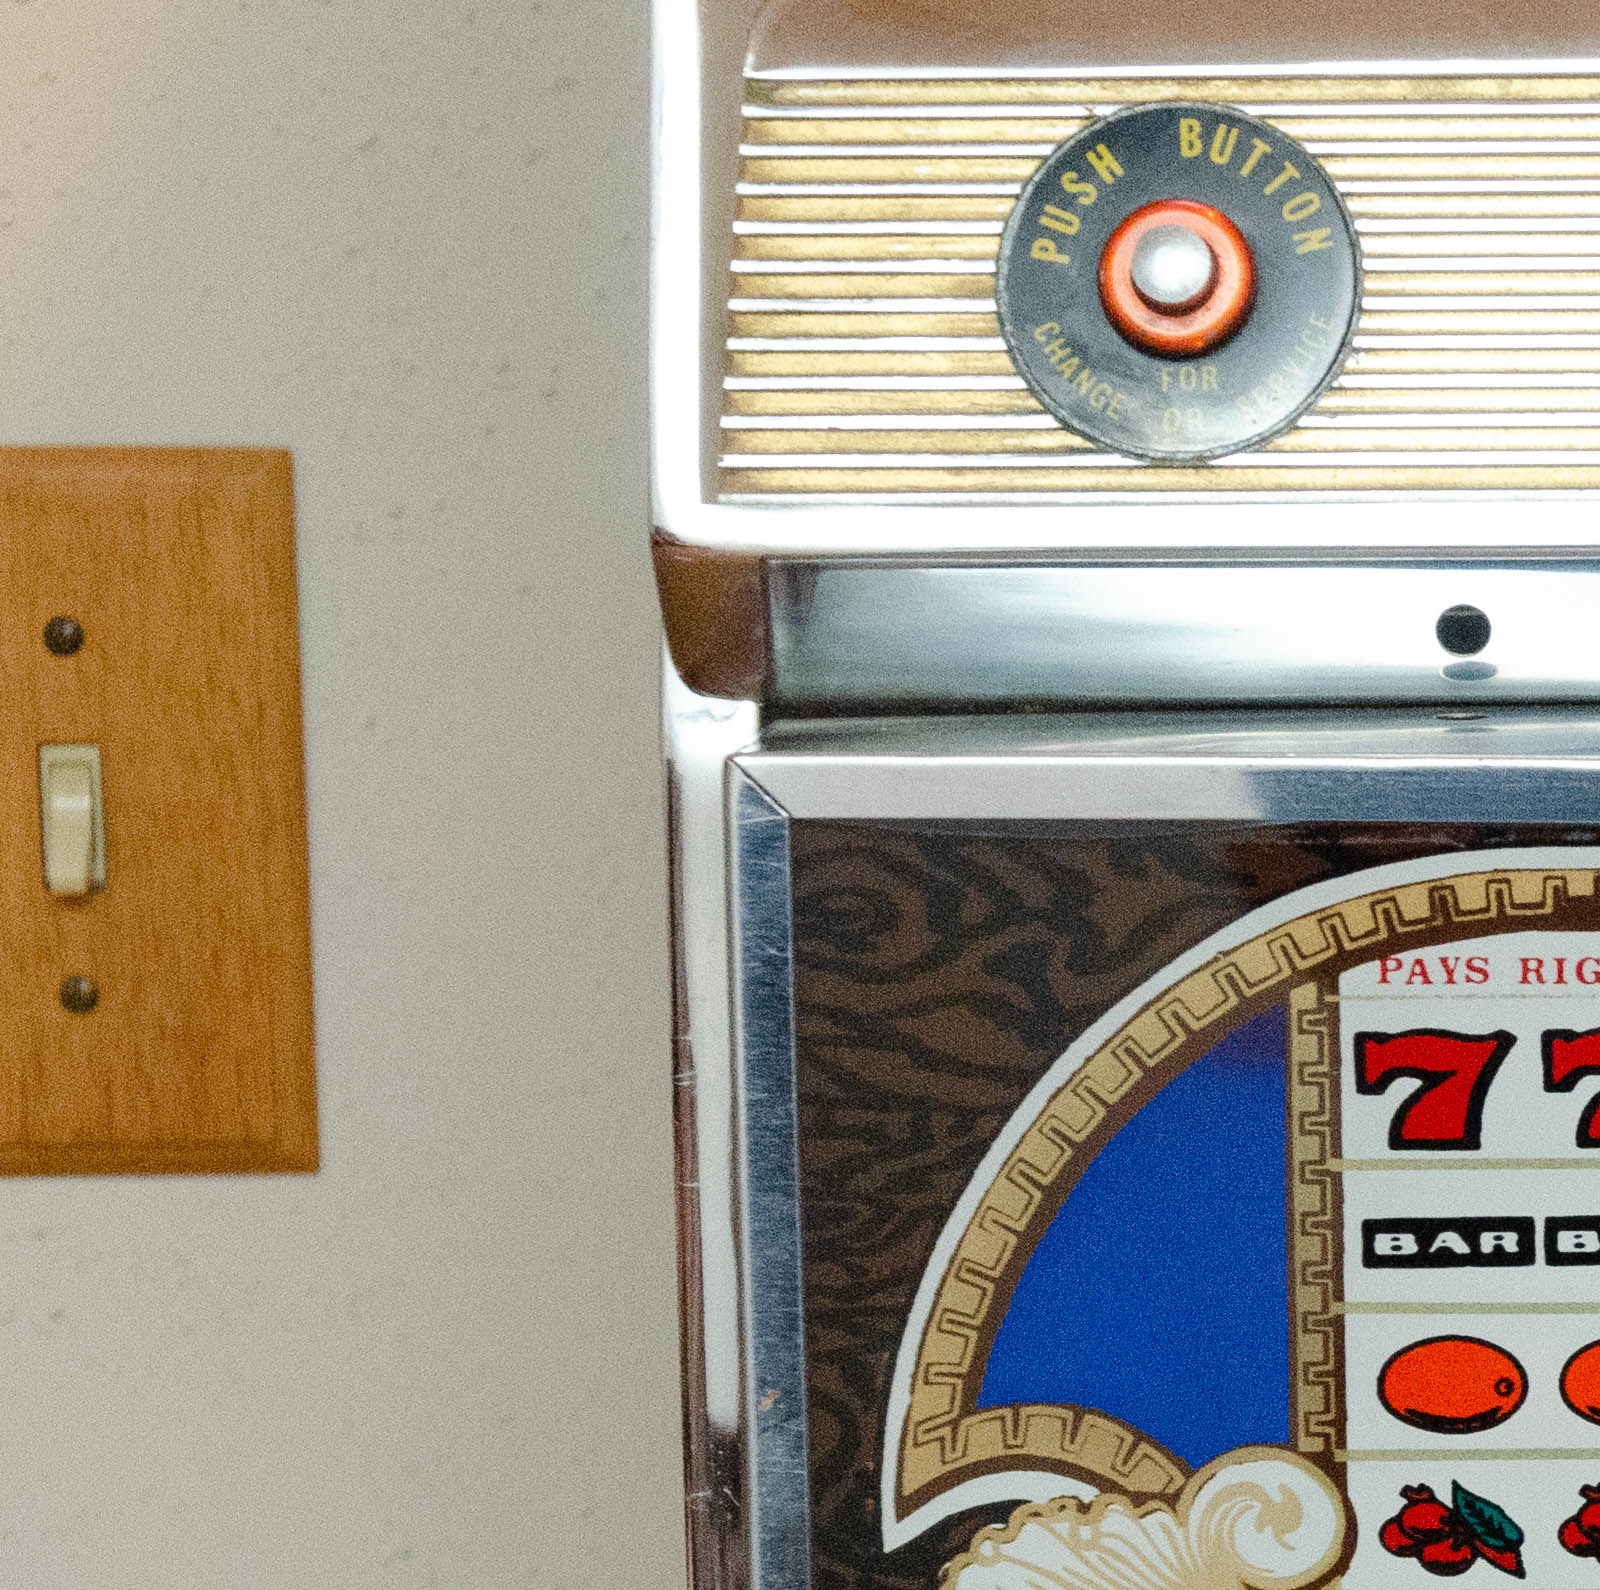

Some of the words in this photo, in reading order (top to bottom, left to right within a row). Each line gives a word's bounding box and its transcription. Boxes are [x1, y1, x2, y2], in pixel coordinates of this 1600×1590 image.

[1031, 144, 1125, 264] PUSH
[1179, 118, 1334, 254] BUTTON
[1033, 321, 1126, 421] CHANGE
[1160, 365, 1220, 392] FOR
[1379, 956, 1491, 985] PAYS
[1353, 1027, 1518, 1152] 7
[1374, 1231, 1520, 1256] BAR
